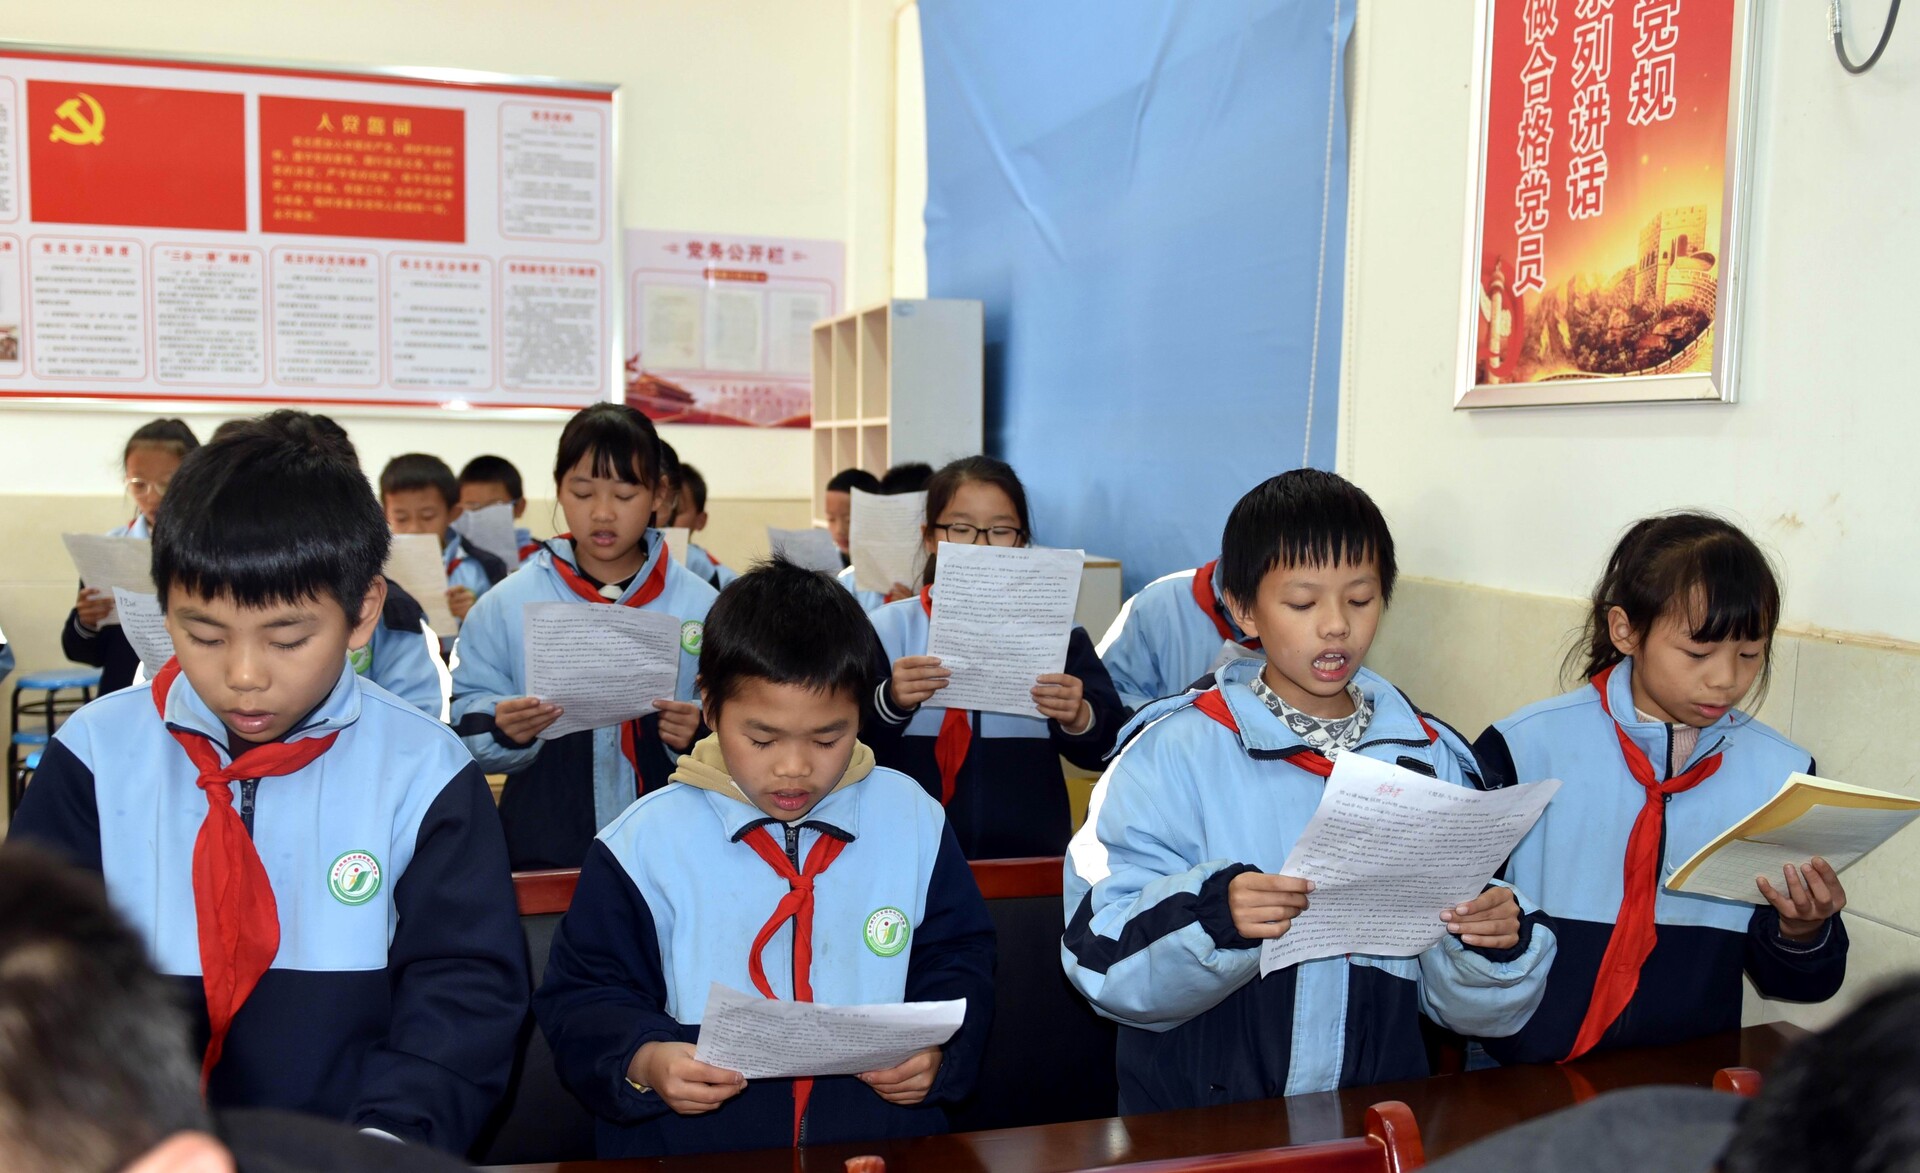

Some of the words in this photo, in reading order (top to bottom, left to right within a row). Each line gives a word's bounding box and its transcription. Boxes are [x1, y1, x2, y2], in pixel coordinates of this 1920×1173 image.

[1627, 0, 1681, 126] 党规
[1513, 0, 1558, 296] 做合格党员
[686, 241, 785, 265] 党务公开栏
